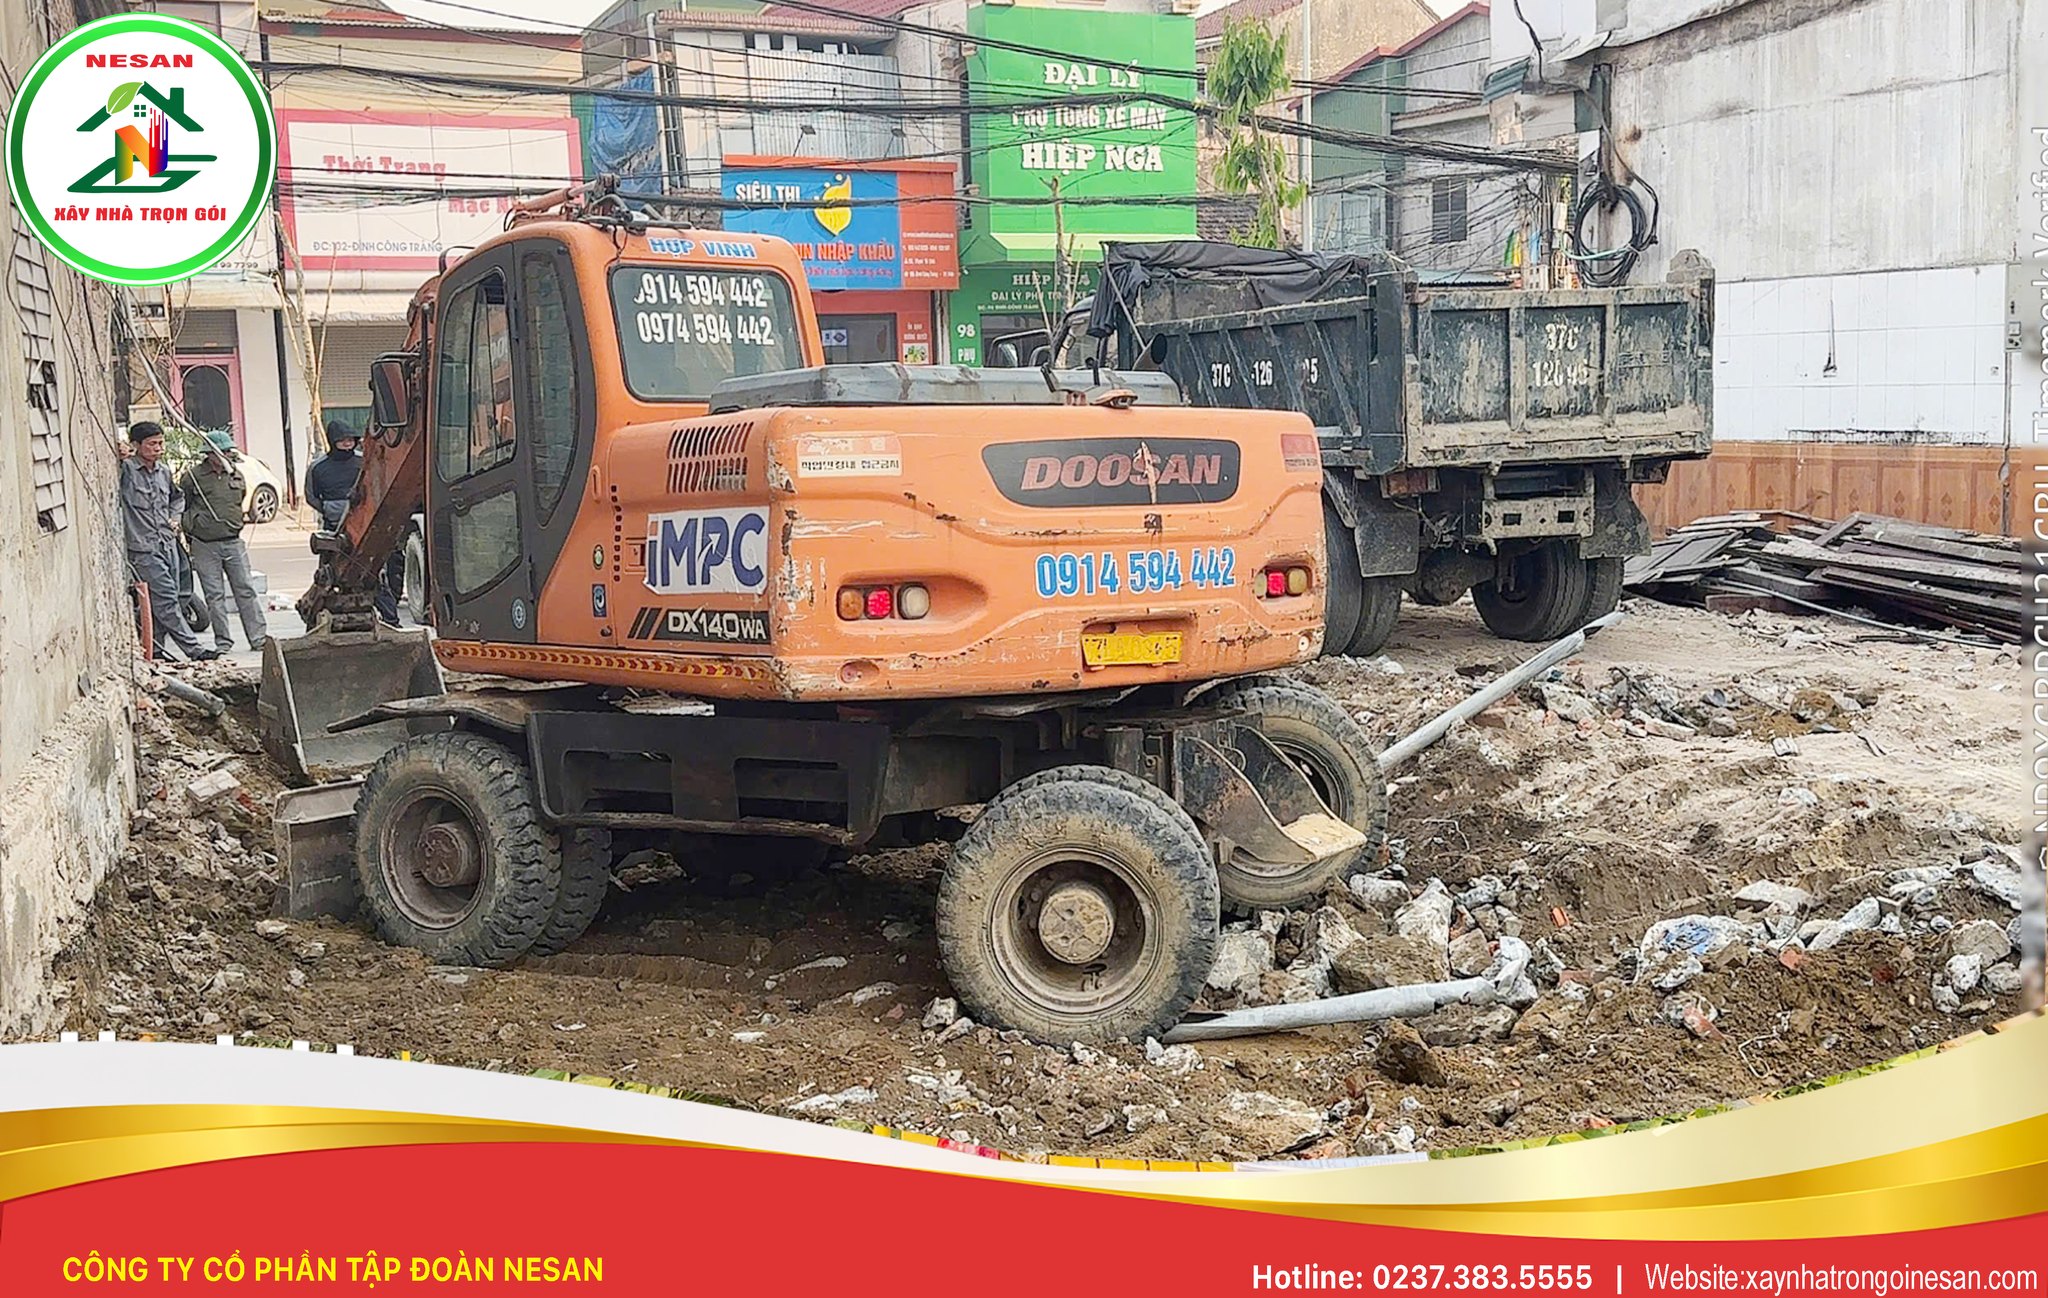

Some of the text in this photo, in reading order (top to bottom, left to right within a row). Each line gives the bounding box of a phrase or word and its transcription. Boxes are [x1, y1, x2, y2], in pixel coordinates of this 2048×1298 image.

[1043, 62, 1098, 91] ĐẠI
[1104, 106, 1127, 129] XE
[379, 156, 446, 181] Trang
[1021, 138, 1165, 176] HIỆP NGA
[702, 239, 758, 258] VINH
[816, 240, 855, 264] NHẬP
[685, 274, 725, 306] 594
[730, 277, 768, 307] 442
[637, 312, 775, 345] 0974 594 442
[957, 324, 976, 338] 98
[1211, 363, 1231, 388] 37C
[1021, 454, 1222, 491] DOOSAN
[1036, 548, 1237, 598] 0914 594 442
[668, 611, 767, 640] DX140WA
